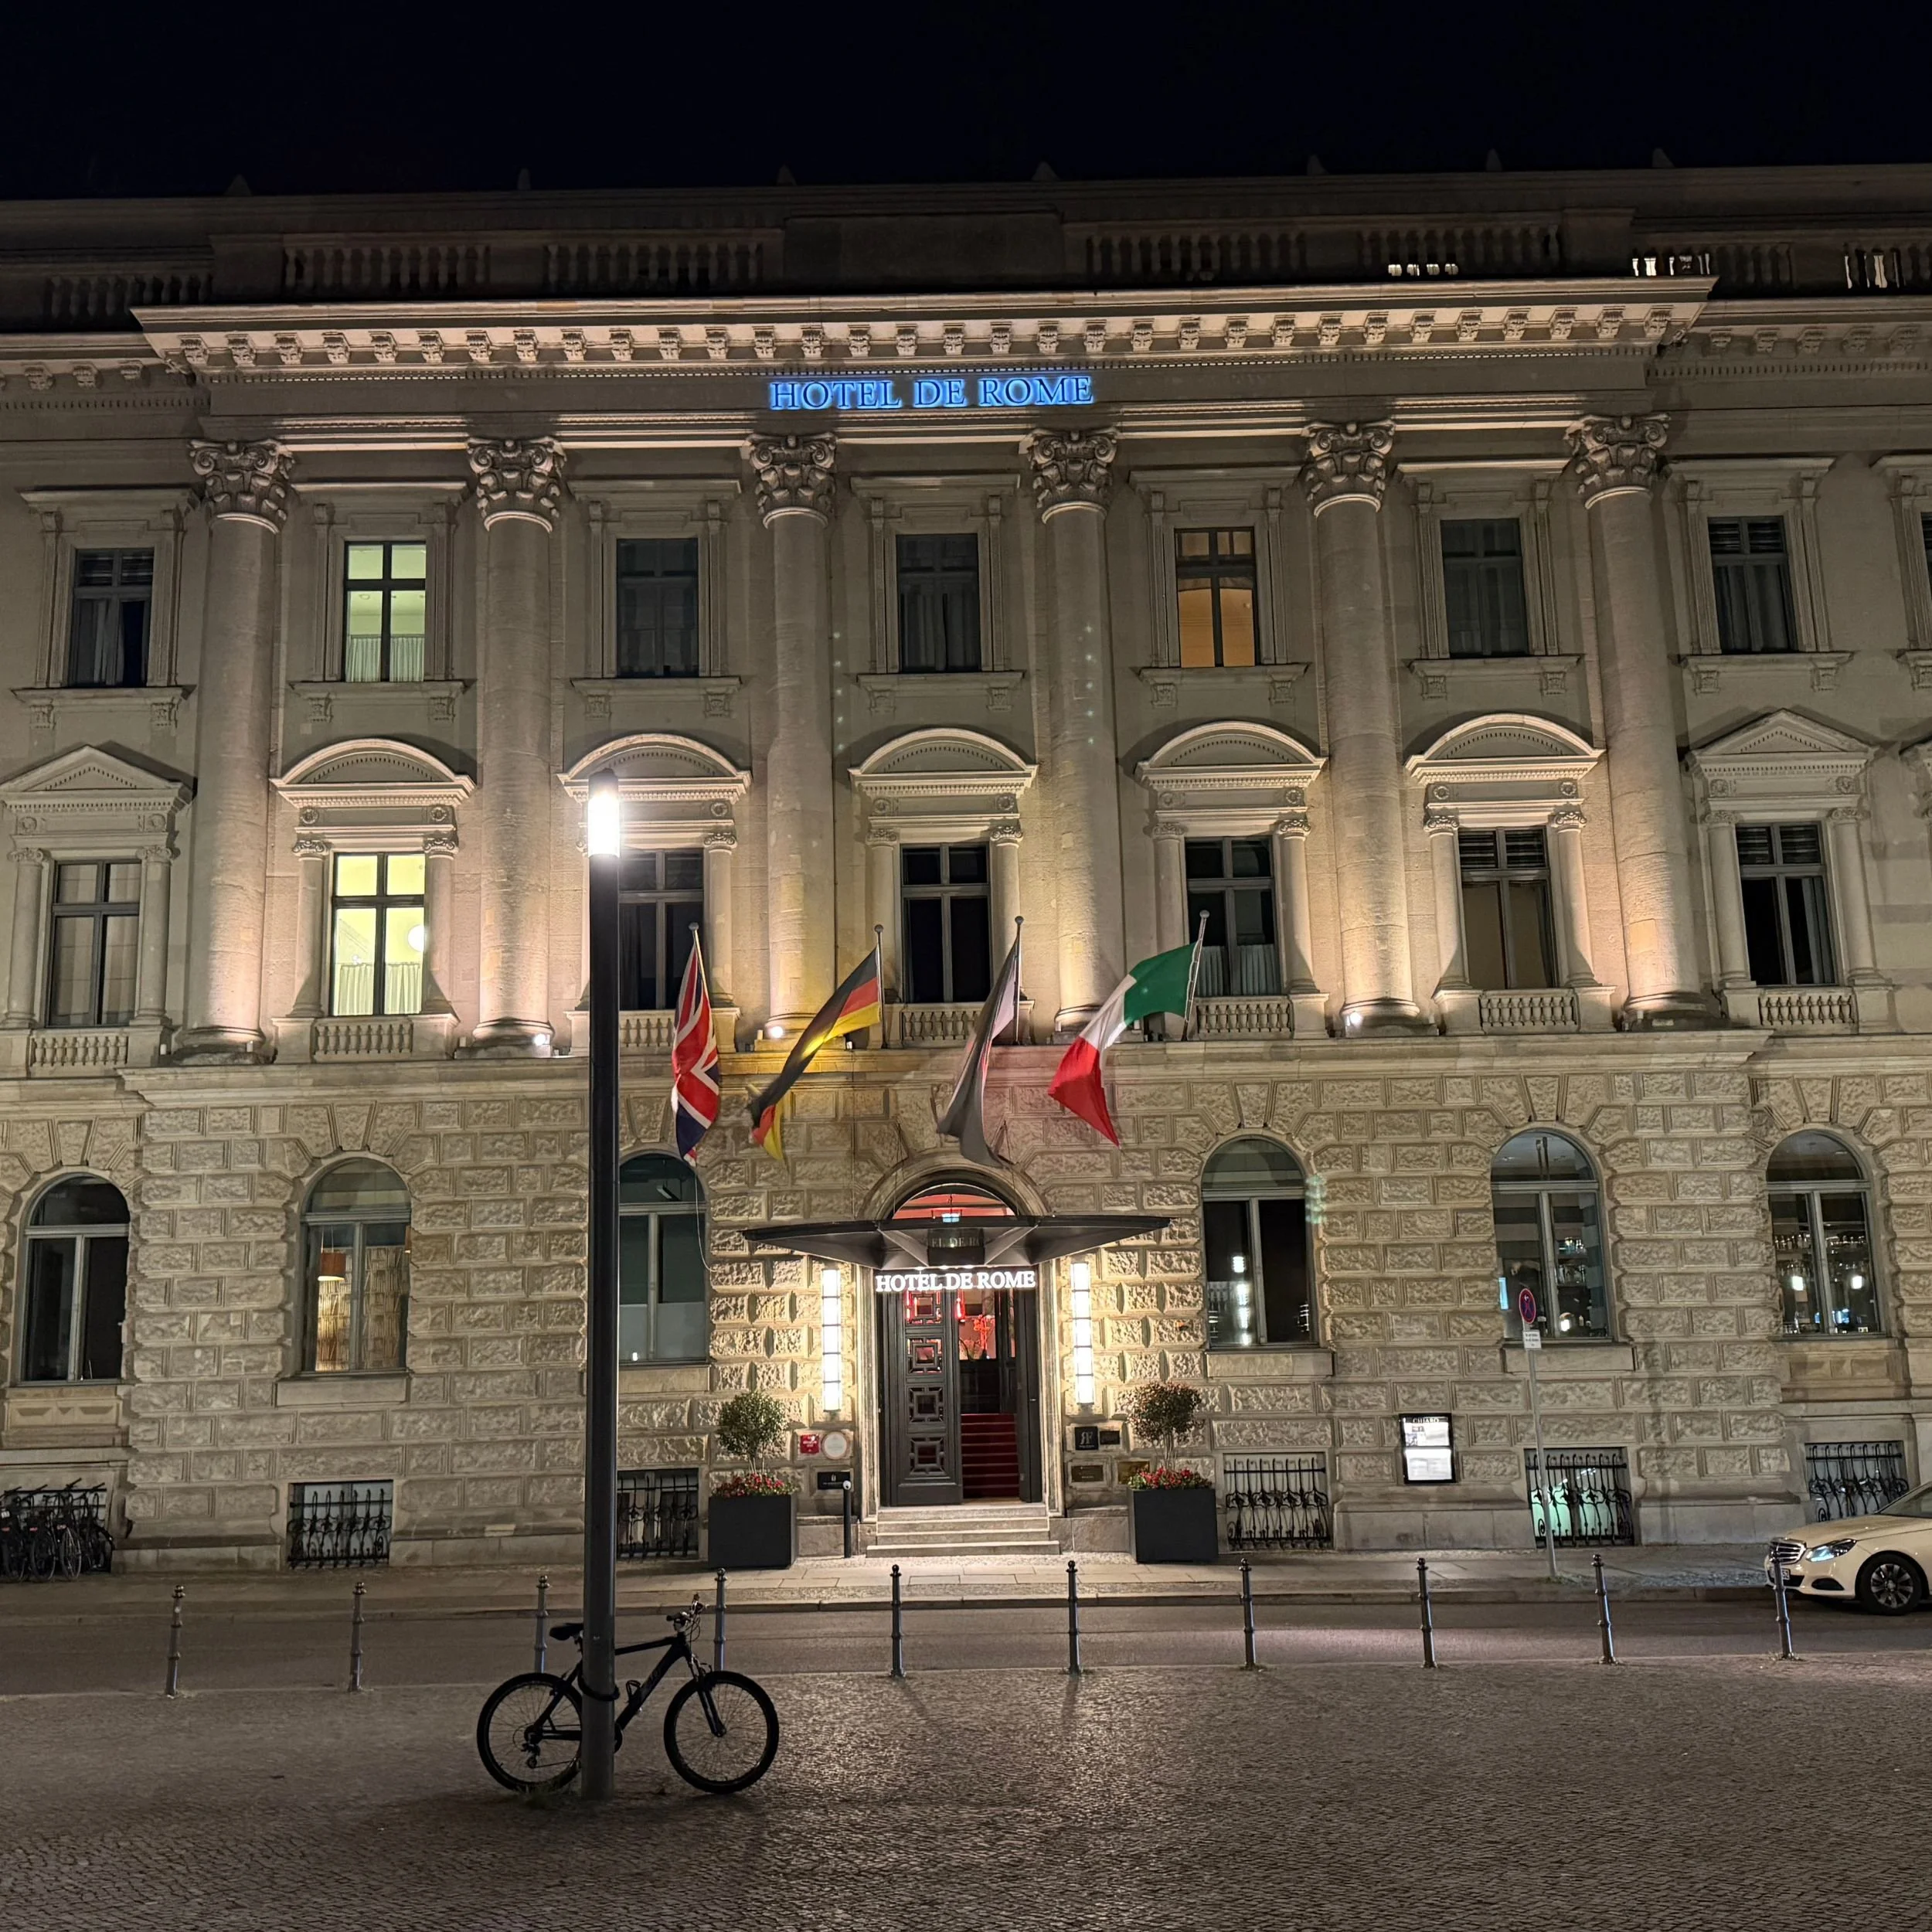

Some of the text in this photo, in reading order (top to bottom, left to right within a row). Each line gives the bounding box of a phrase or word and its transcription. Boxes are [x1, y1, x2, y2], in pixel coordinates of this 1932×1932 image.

[770, 376, 1094, 409] HOTEL DE ROME
[876, 1270, 1036, 1291] HOTEL DE ROME
